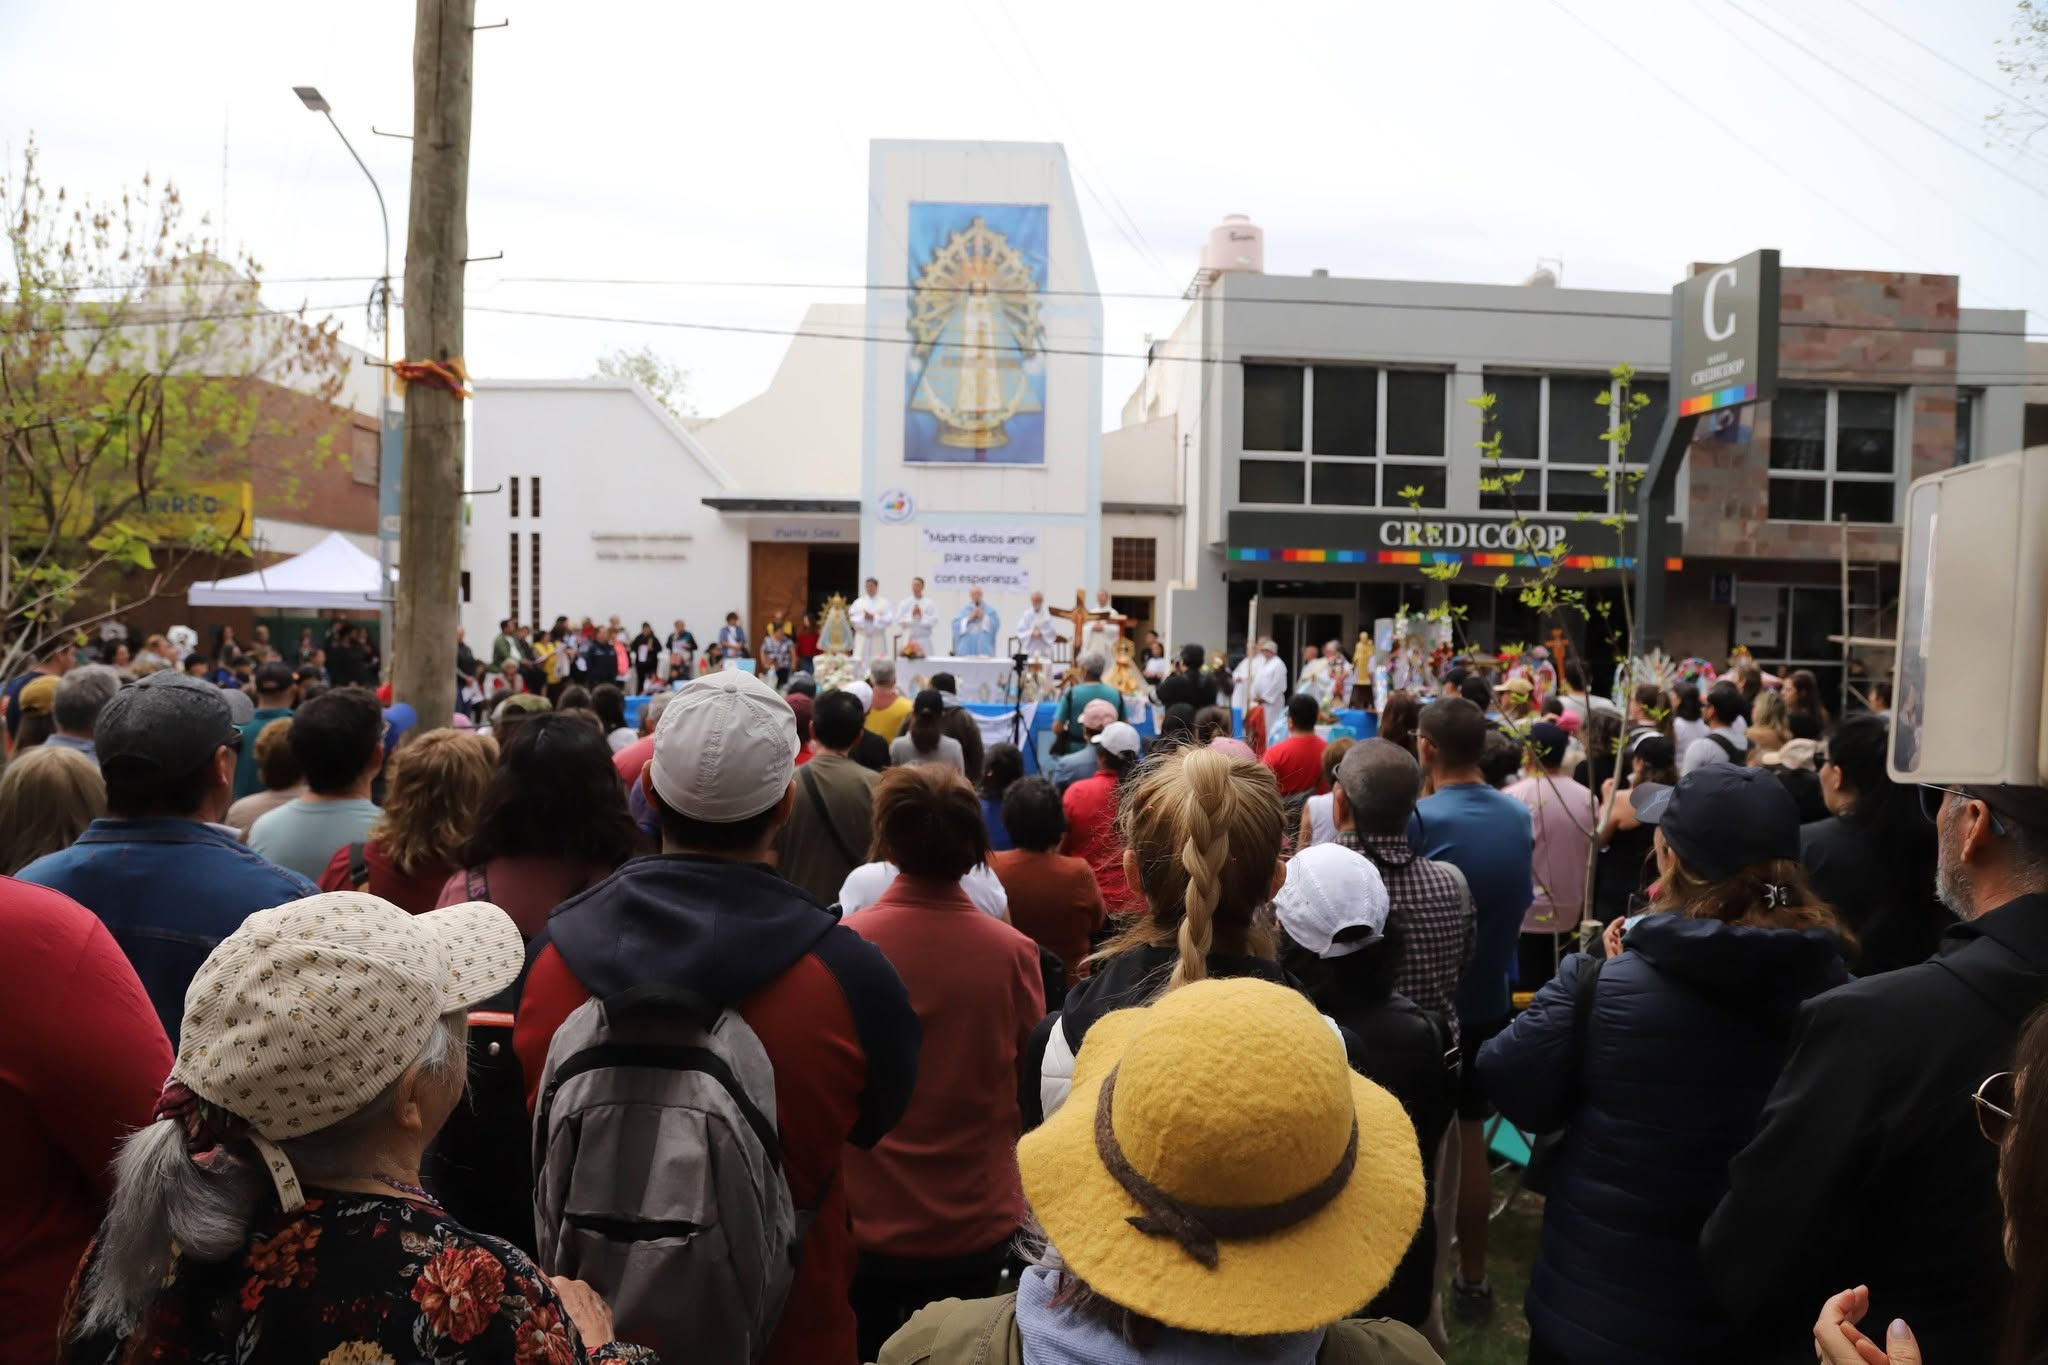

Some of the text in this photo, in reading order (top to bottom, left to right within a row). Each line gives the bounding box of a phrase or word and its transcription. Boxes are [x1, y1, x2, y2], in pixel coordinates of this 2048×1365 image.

[1703, 266, 1737, 342] C
[969, 533, 1004, 544] danos
[1006, 535, 1036, 545] amor
[1379, 520, 1566, 549] CREDICOOP
[943, 552, 1019, 564] para caminar
[934, 574, 957, 584] con
